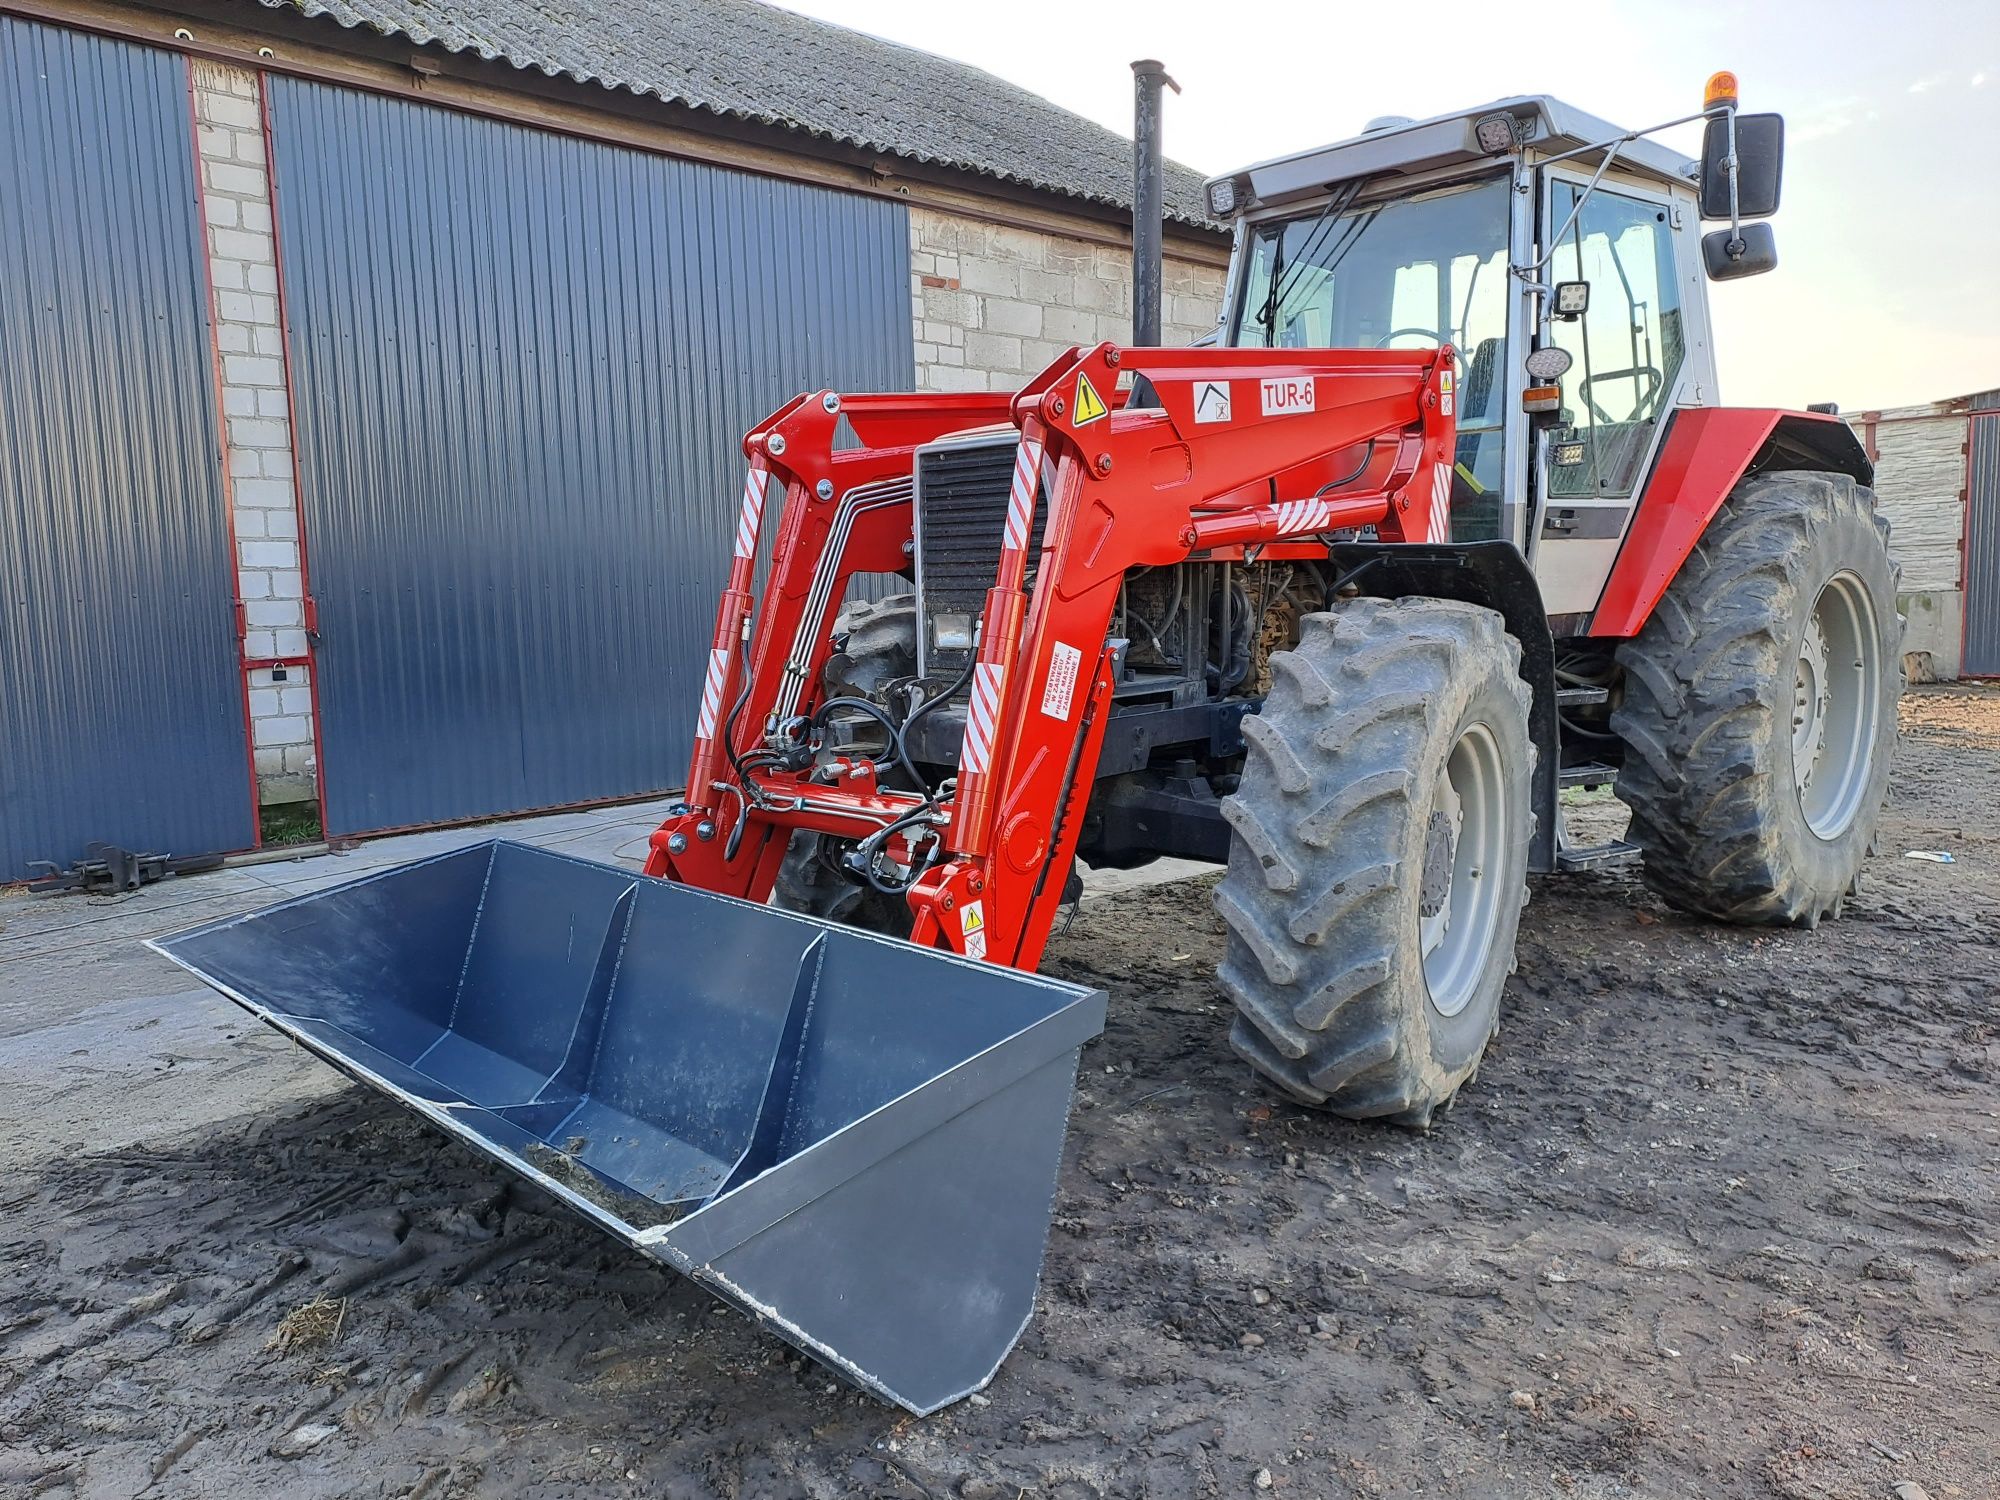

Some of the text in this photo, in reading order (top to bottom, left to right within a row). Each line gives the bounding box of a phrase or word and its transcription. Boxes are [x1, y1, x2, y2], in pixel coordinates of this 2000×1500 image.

[1264, 382, 1312, 408] TUR-6
[1044, 652, 1059, 708] PRZEBYWANIE
[1056, 650, 1073, 714] PRACY MASZYNY
